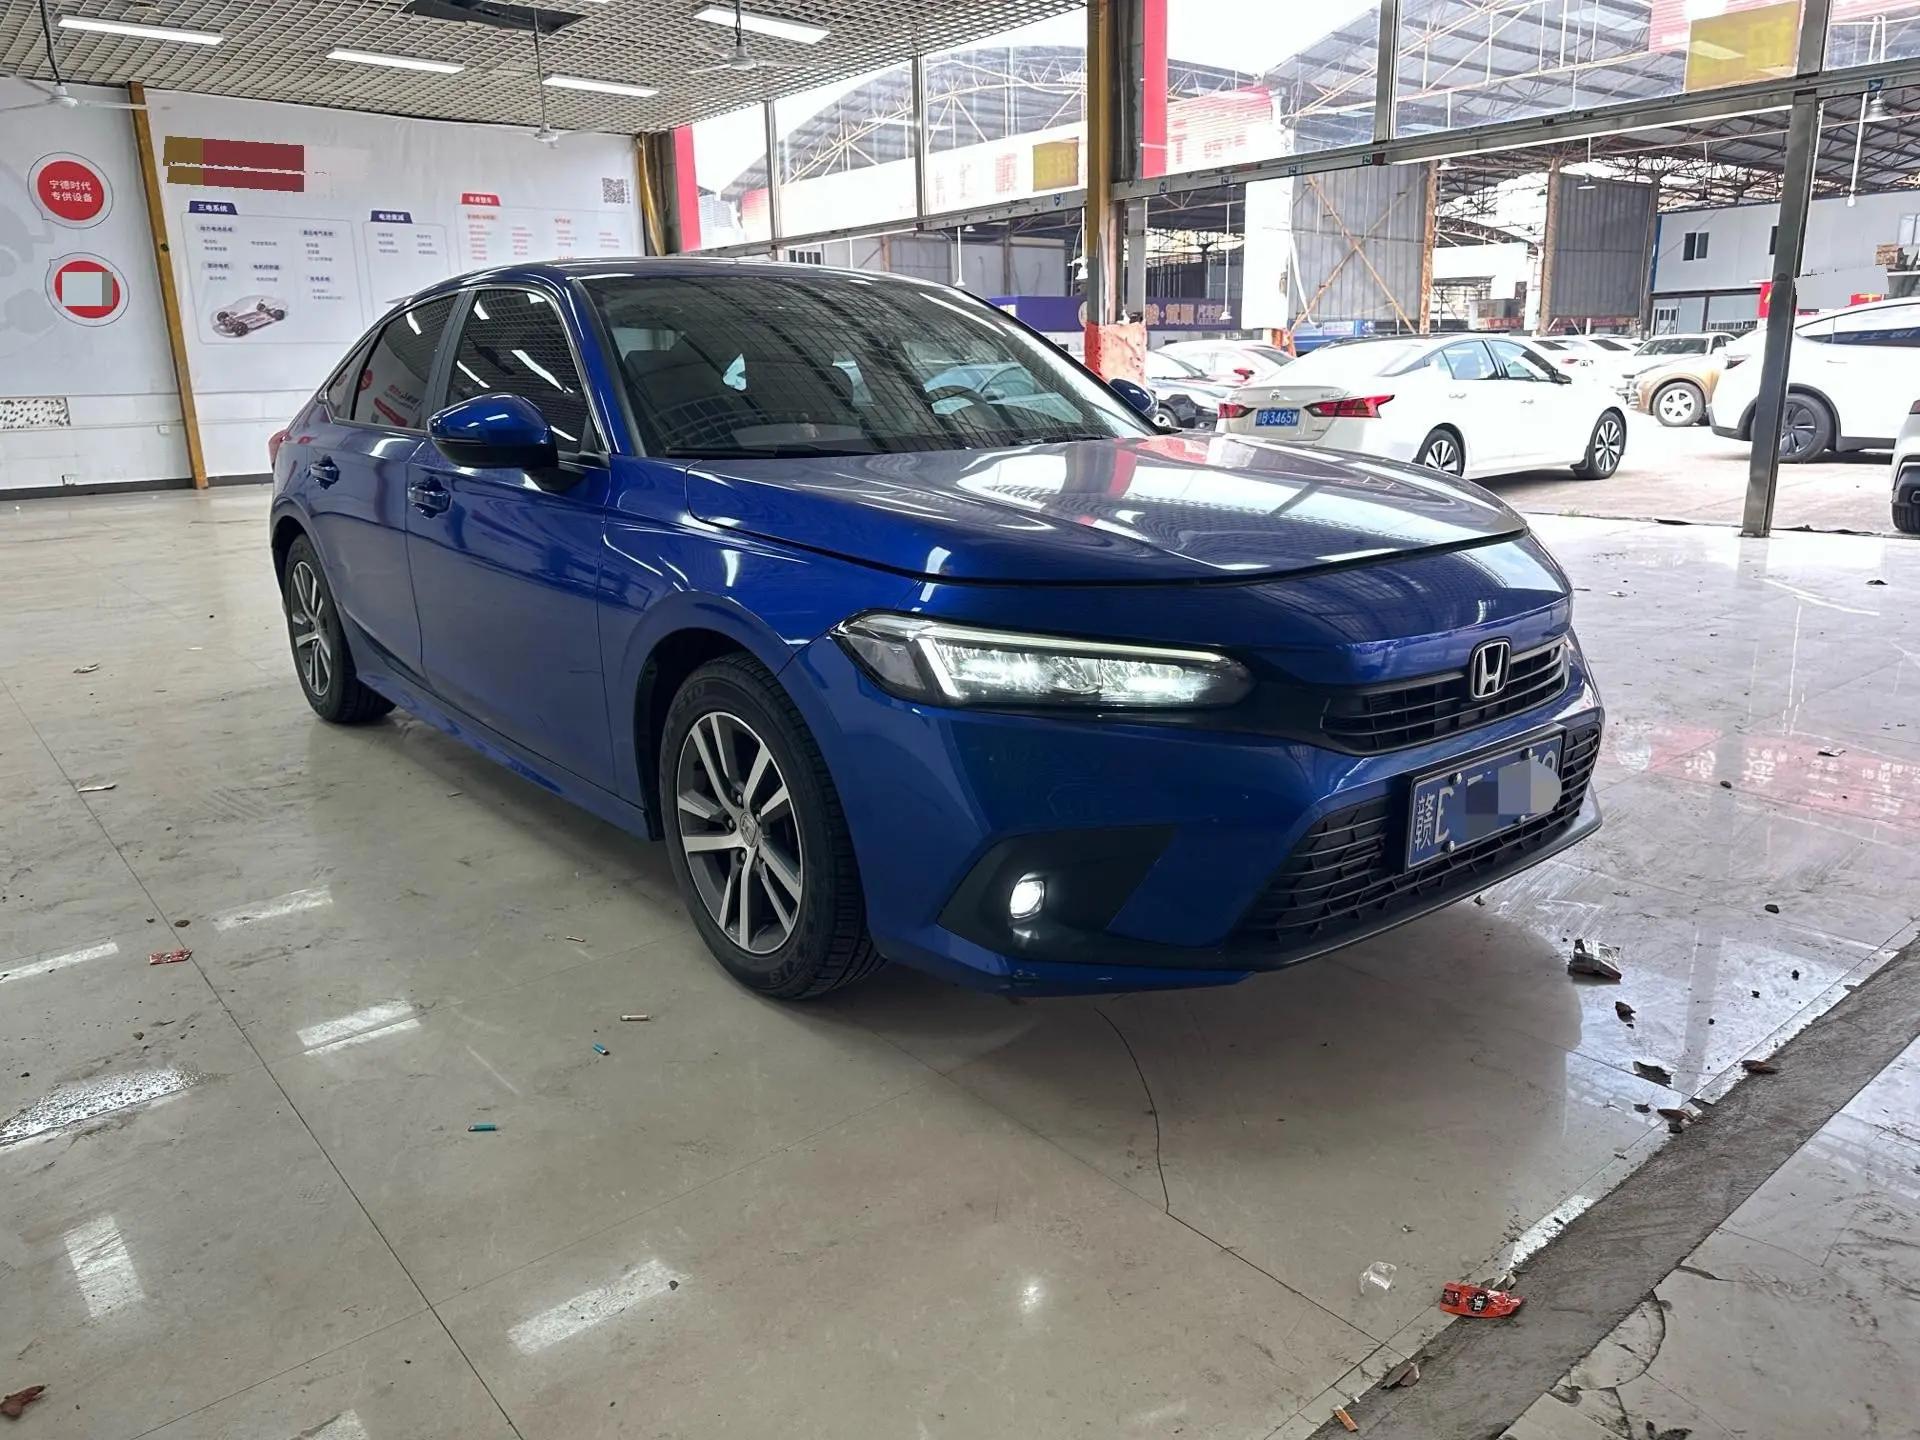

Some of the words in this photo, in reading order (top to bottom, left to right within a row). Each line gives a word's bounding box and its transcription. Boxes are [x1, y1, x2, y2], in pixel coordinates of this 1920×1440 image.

[49, 179, 92, 191] 宁德时代
[51, 191, 93, 203] 专供设备
